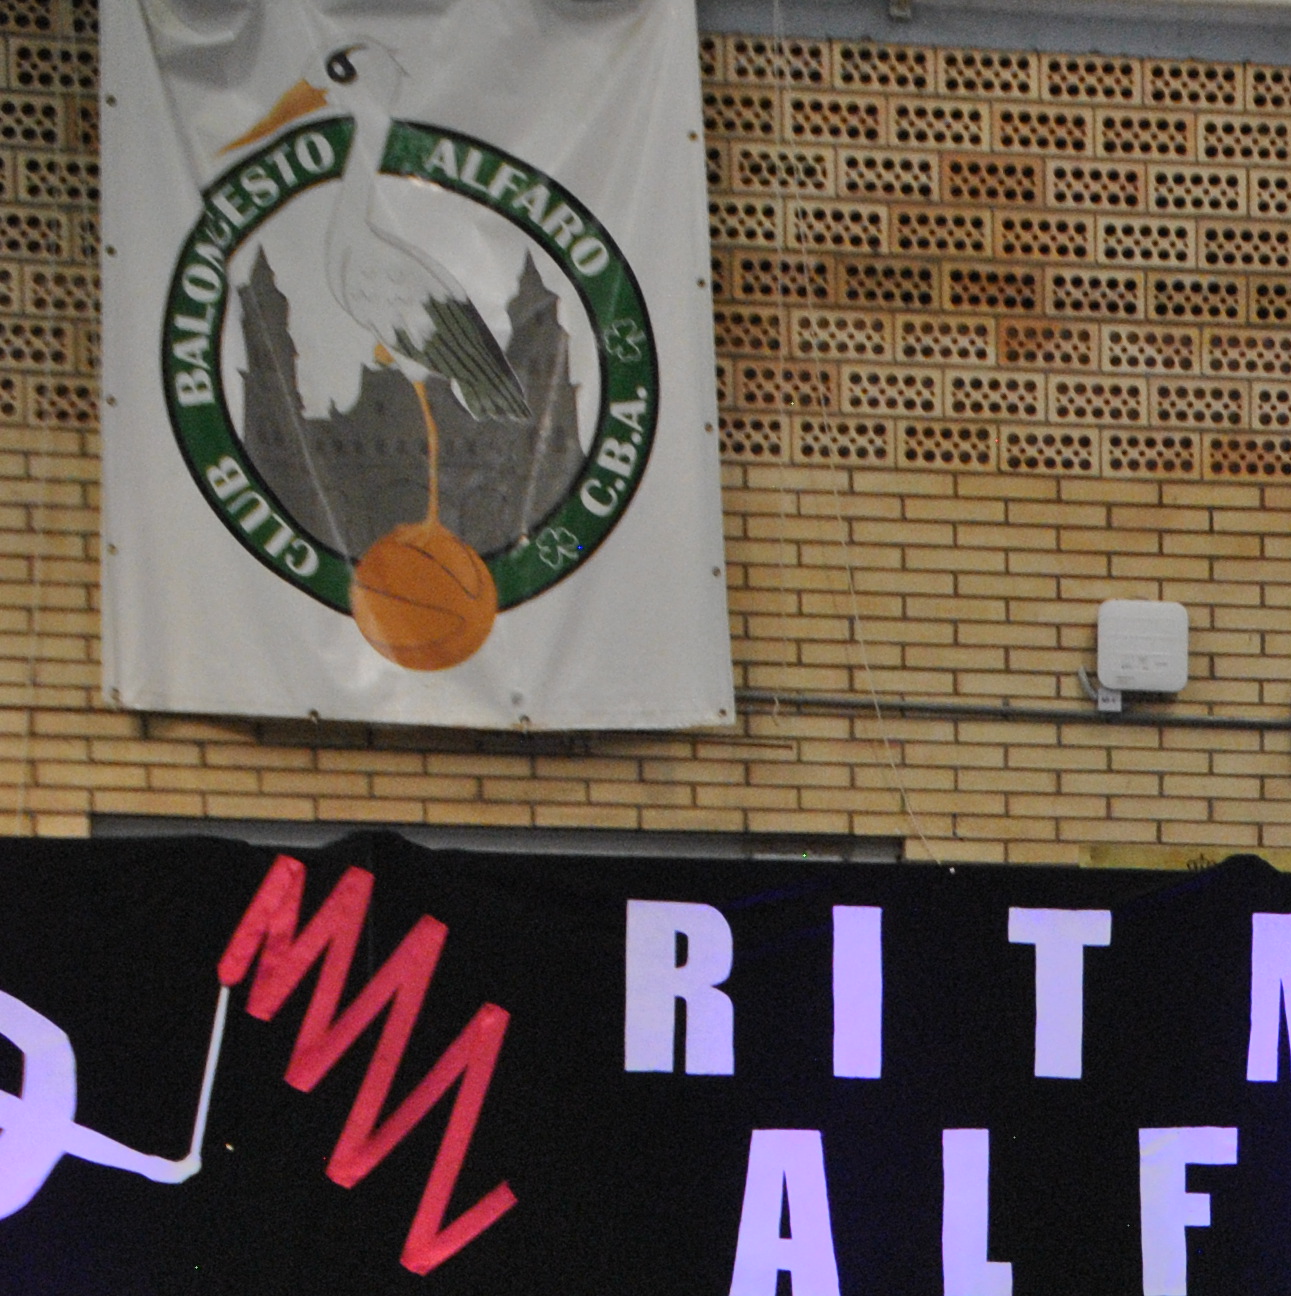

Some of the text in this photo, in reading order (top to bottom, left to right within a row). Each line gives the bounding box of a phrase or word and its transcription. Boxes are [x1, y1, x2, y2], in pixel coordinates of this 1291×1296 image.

[205, 455, 320, 577] CLUB
[423, 137, 610, 277] ALFARO
[580, 385, 649, 518] C.B.A.
